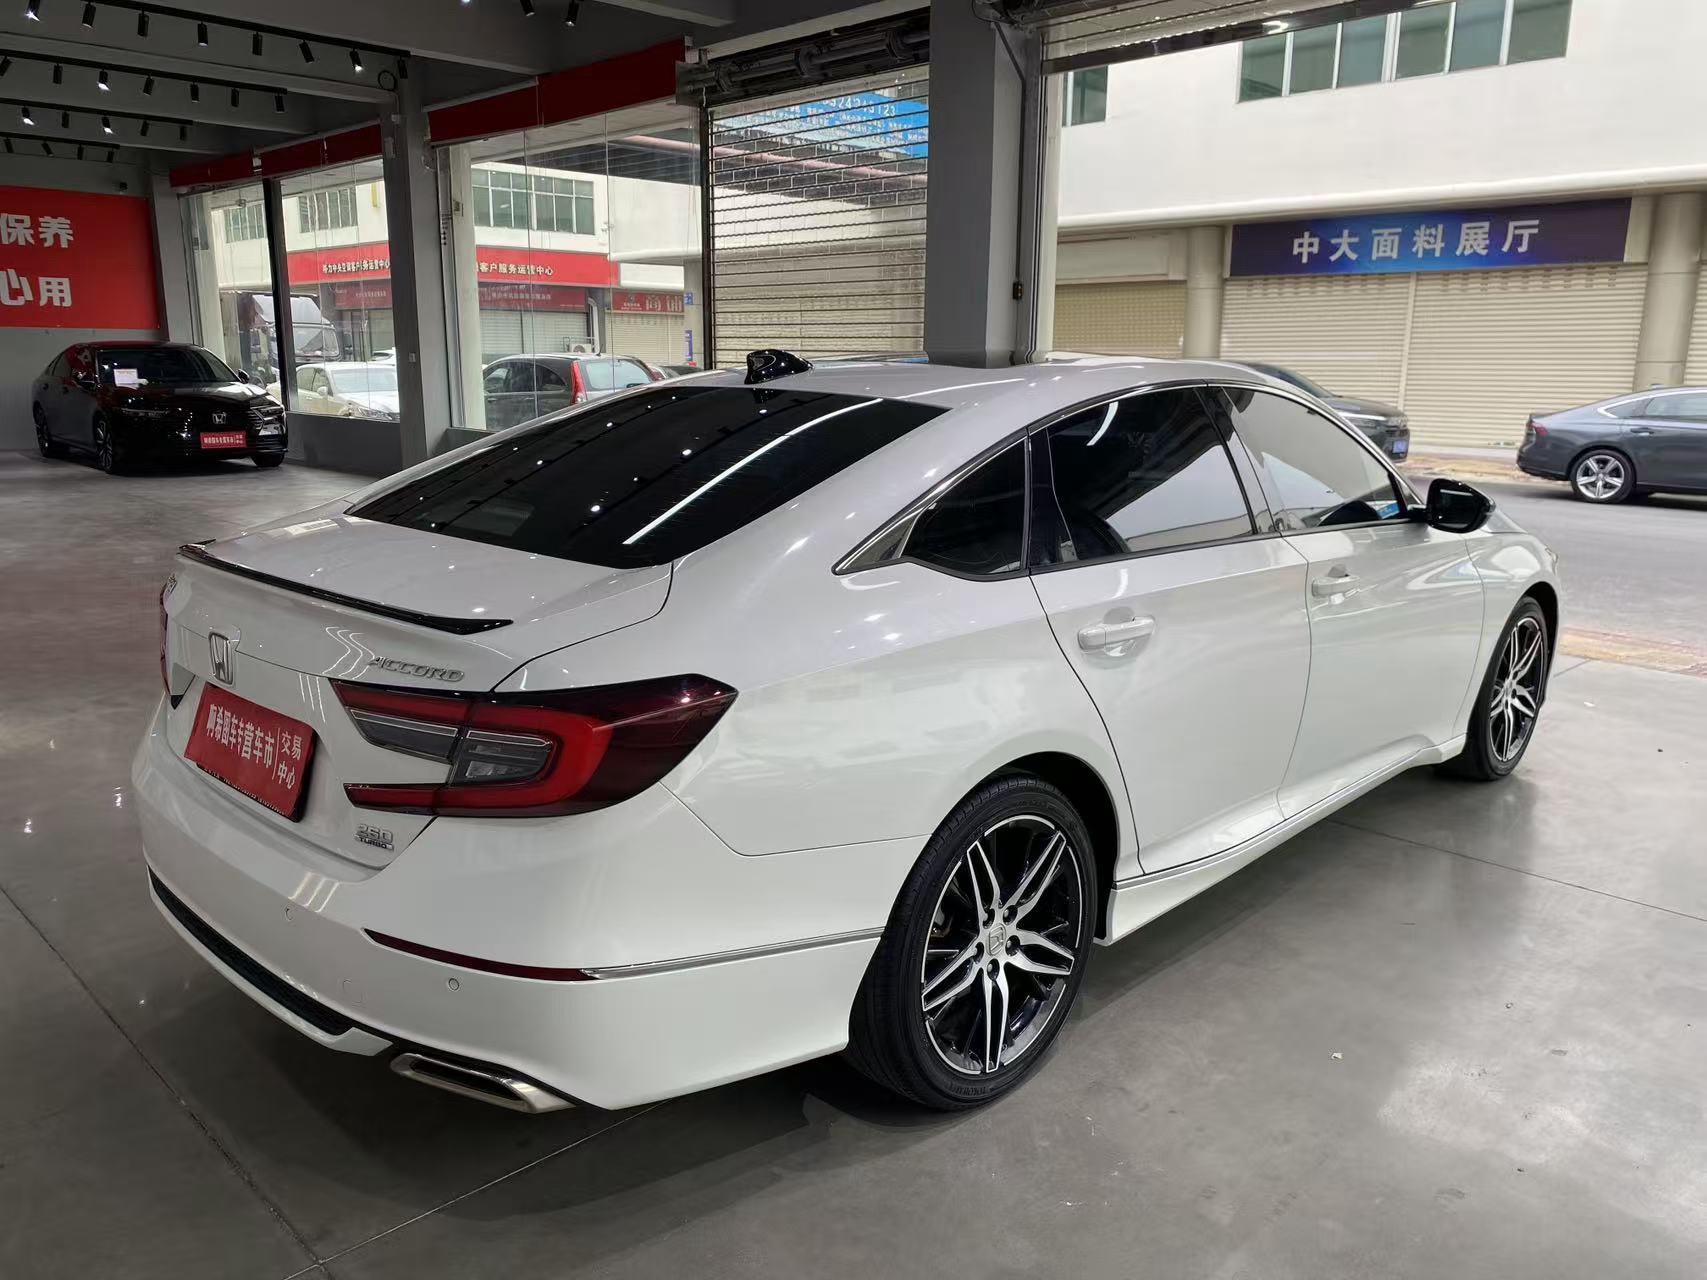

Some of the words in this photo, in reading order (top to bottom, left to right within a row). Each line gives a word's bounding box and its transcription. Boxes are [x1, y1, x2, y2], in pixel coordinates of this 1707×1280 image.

[0, 213, 74, 248] 保养
[1291, 219, 1540, 264] 中大面料展厅
[0, 268, 72, 308] 心用
[368, 656, 465, 682] ACCORD
[280, 731, 302, 760] 交易
[277, 761, 296, 790] 中心
